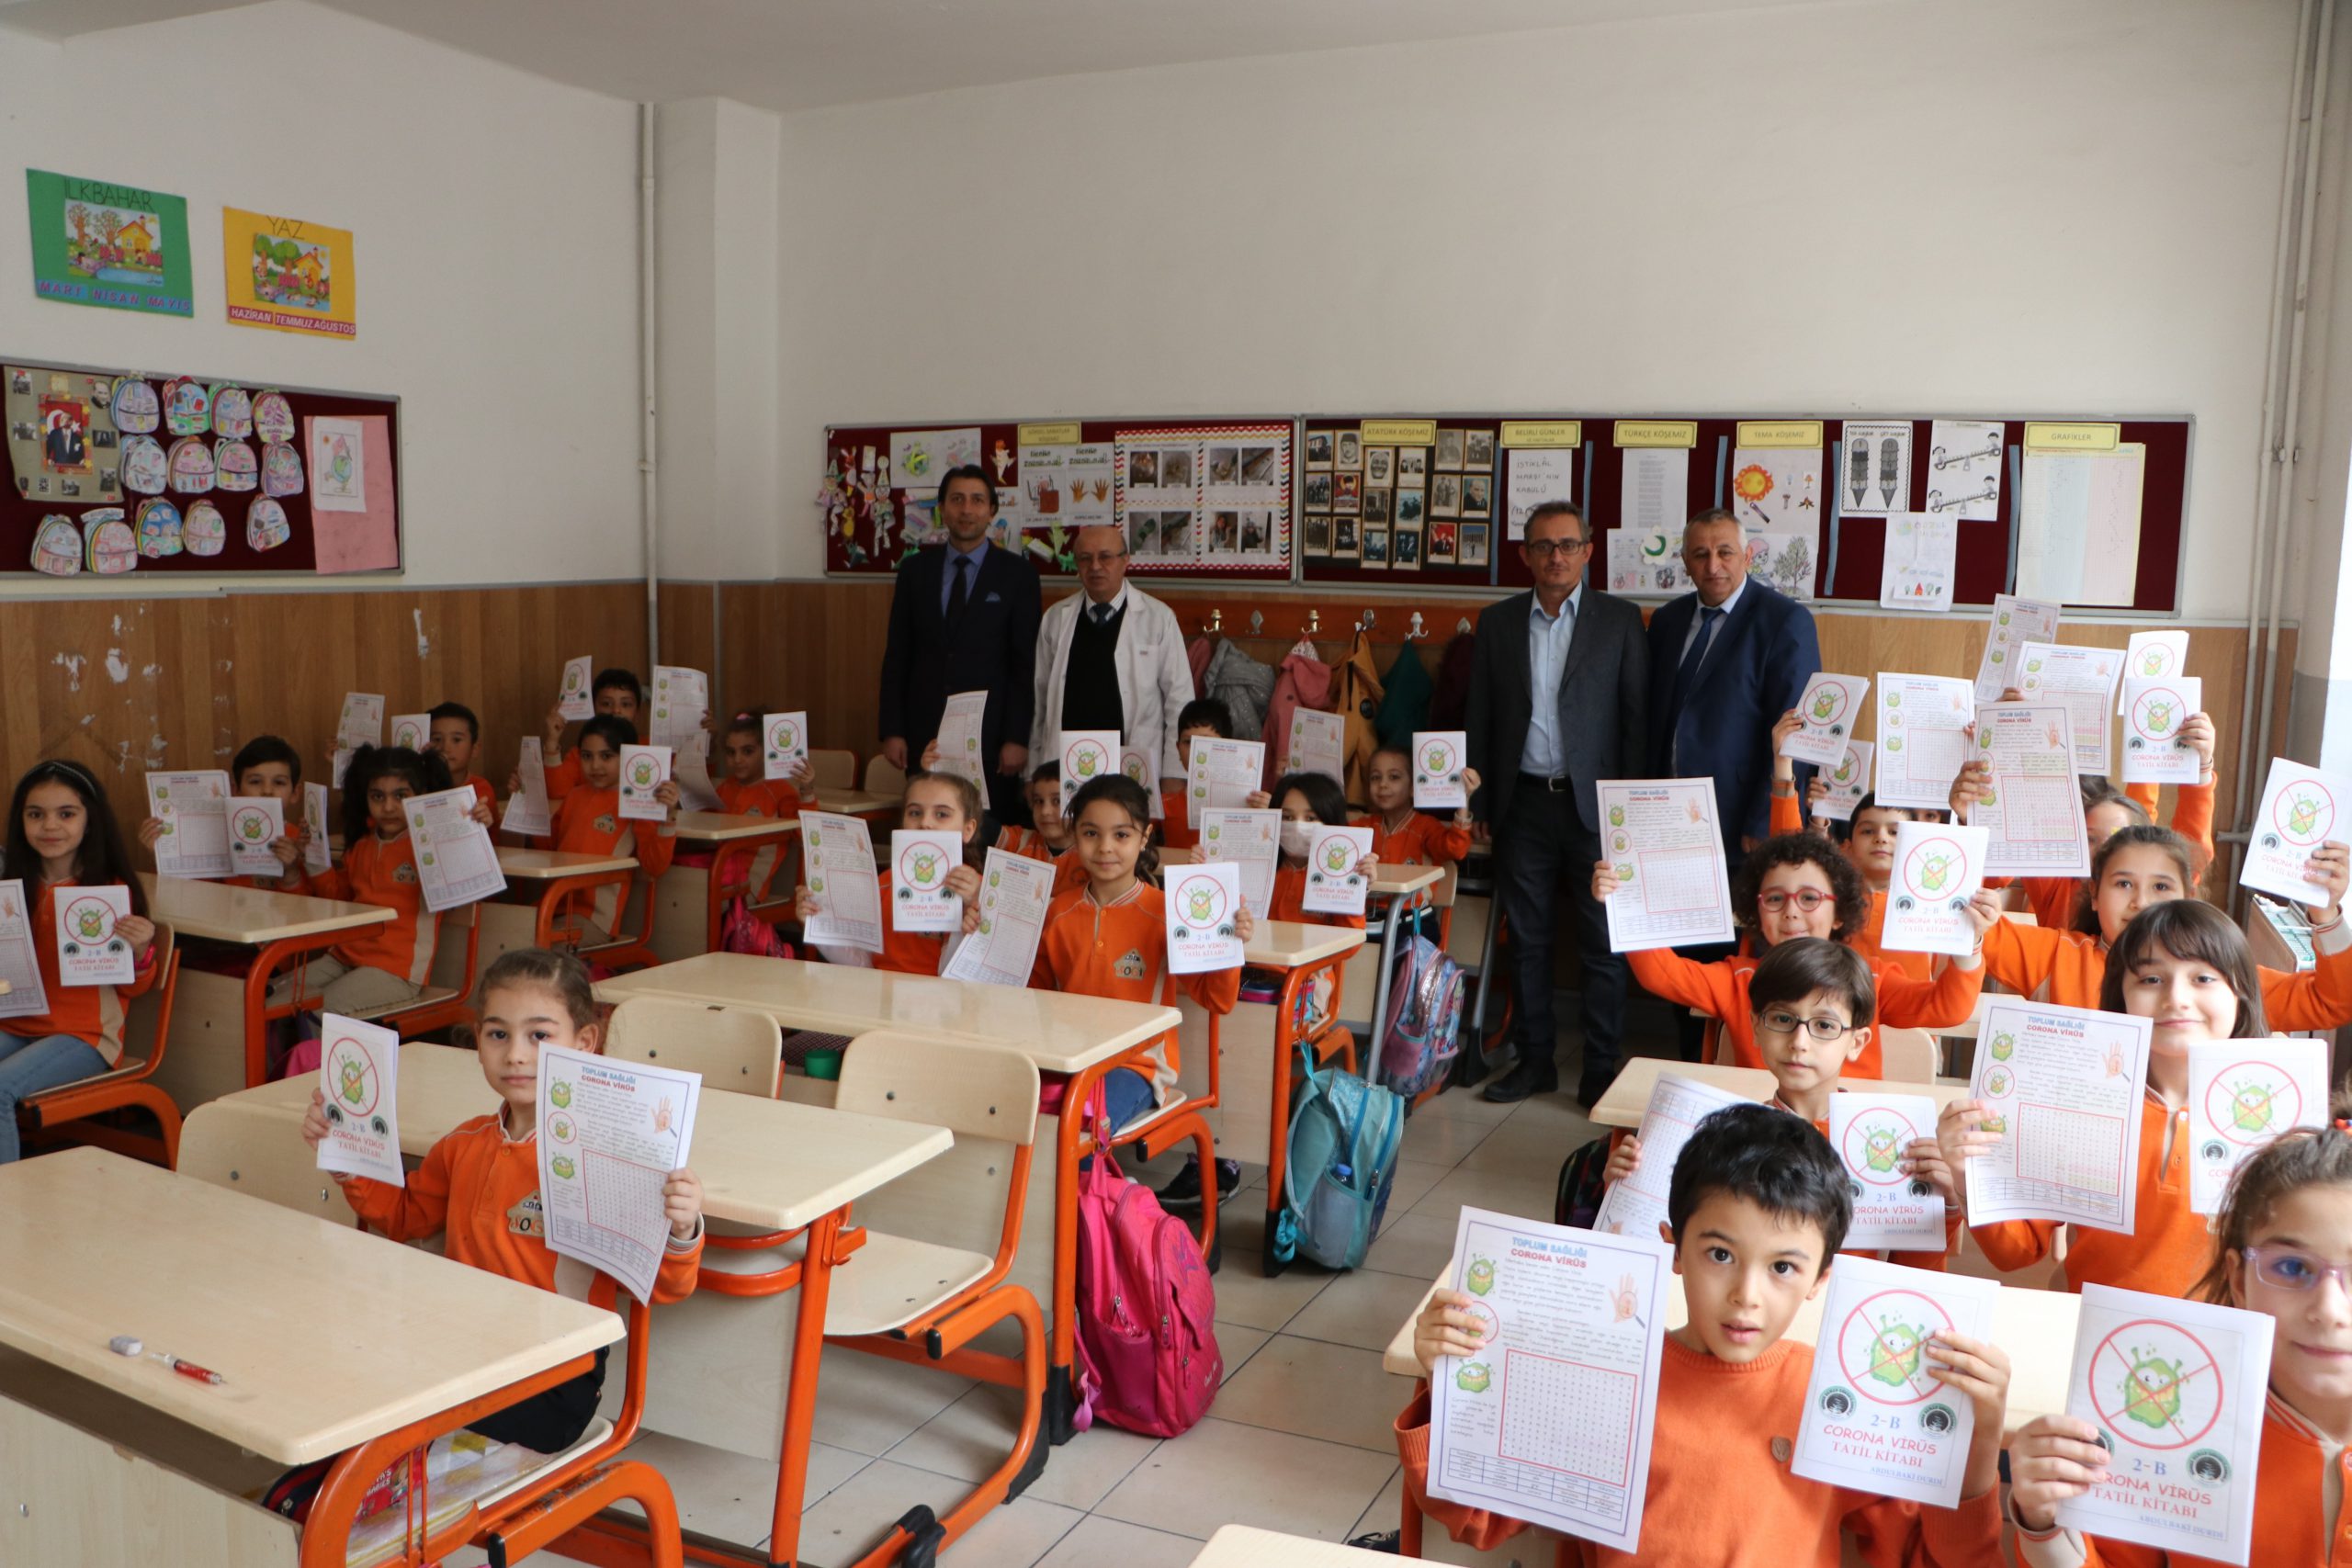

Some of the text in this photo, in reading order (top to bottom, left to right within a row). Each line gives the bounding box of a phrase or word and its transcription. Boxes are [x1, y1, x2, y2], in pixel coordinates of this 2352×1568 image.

[266, 215, 305, 240] YAZ
[39, 281, 82, 296] MART
[147, 295, 190, 310] MAYIS
[231, 307, 356, 333] HAZİRAN TEMMUZ AĞUSTOS
[1366, 427, 1429, 436] ATATÜRK KÖŞEMİZ
[1540, 427, 1566, 435] GÜNLER
[1624, 428, 1687, 440] TÜRKÇE KÖŞEMİZ
[1754, 430, 1804, 440] TEMA KÖŞEMİZ
[2051, 432, 2091, 441] GRAFİKLER
[2027, 1024, 2058, 1033] CORONA
[581, 1075, 611, 1087] CORONA
[332, 1129, 386, 1151] CORONA VİRÜS
[1853, 1205, 1888, 1214] ORONA
[1512, 1236, 1588, 1258] TOPLUM SAĞLIĞI
[1510, 1247, 1587, 1269] CORONA VİRÜS
[1823, 1424, 1938, 1455] CORONA VİRÜS
[1832, 1440, 1923, 1468] TATİL KİTABI
[2105, 1472, 2150, 1492] RONA
[2093, 1486, 2198, 1518] TATİL KİTABI
